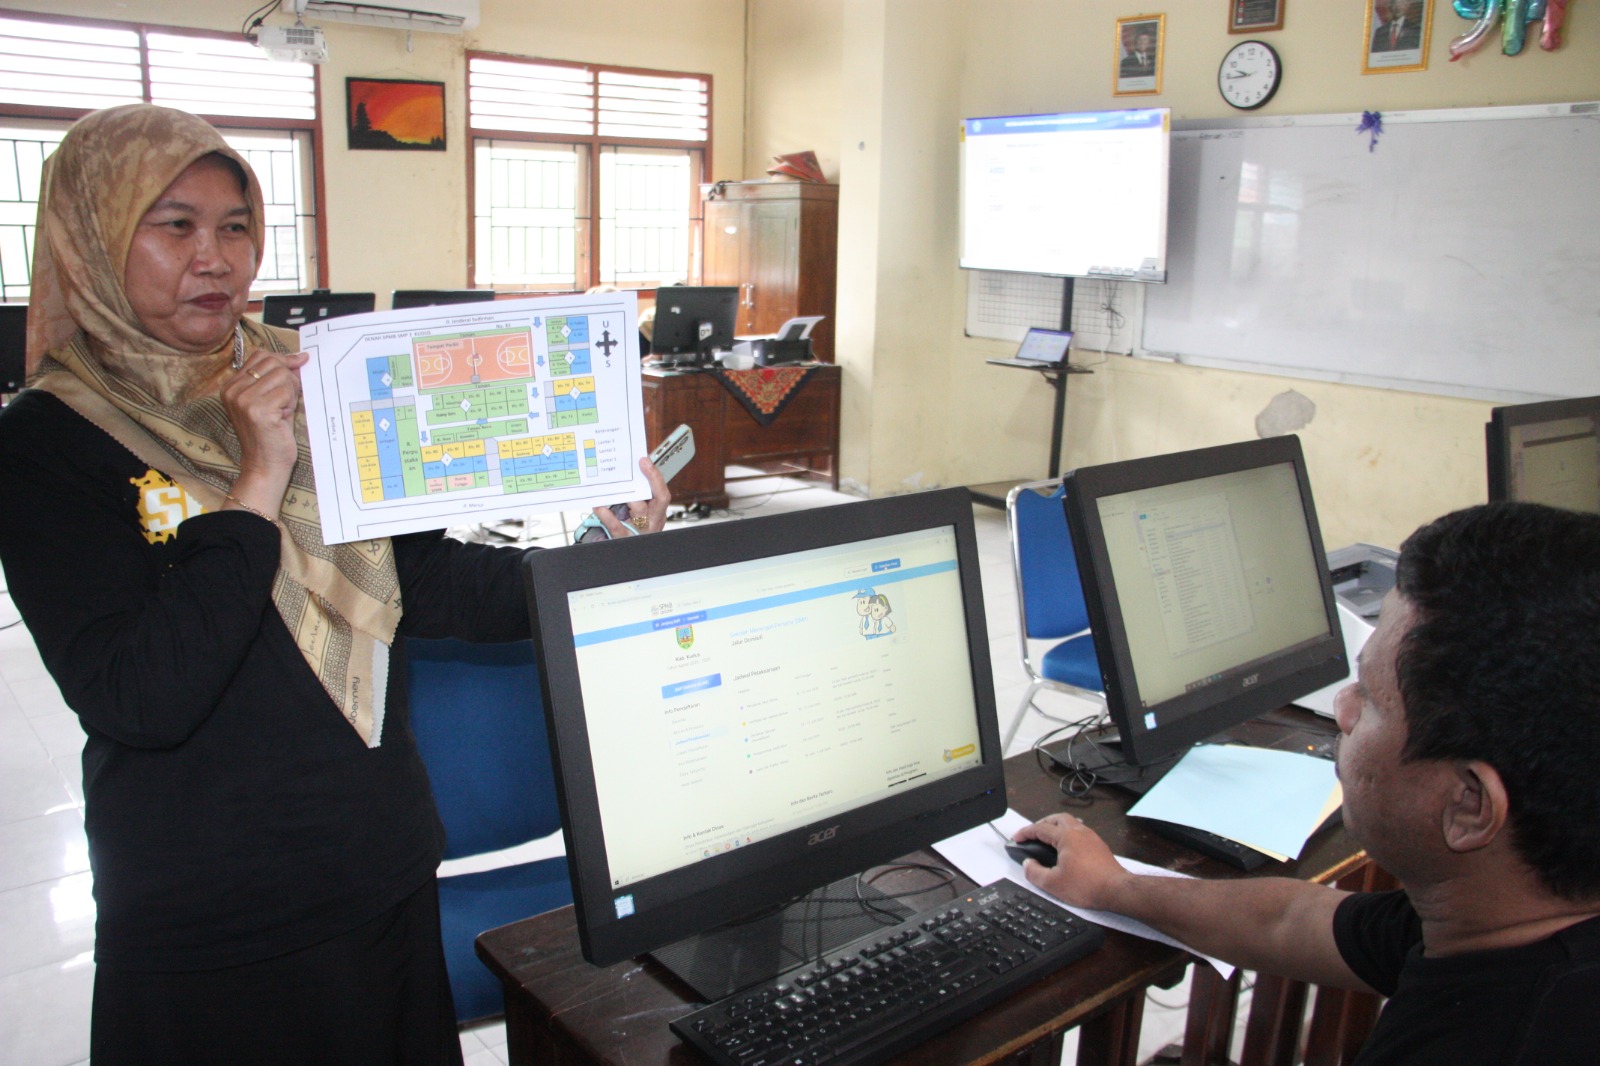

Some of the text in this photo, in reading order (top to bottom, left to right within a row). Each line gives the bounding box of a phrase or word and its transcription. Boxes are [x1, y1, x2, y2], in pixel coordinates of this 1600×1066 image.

[602, 320, 610, 328] U
[606, 360, 612, 368] S
[733, 666, 780, 681] Jadwal Pelaksanaan
[1243, 674, 1259, 687] acer
[674, 703, 700, 712] Pendaftaran
[808, 825, 840, 845] acer
